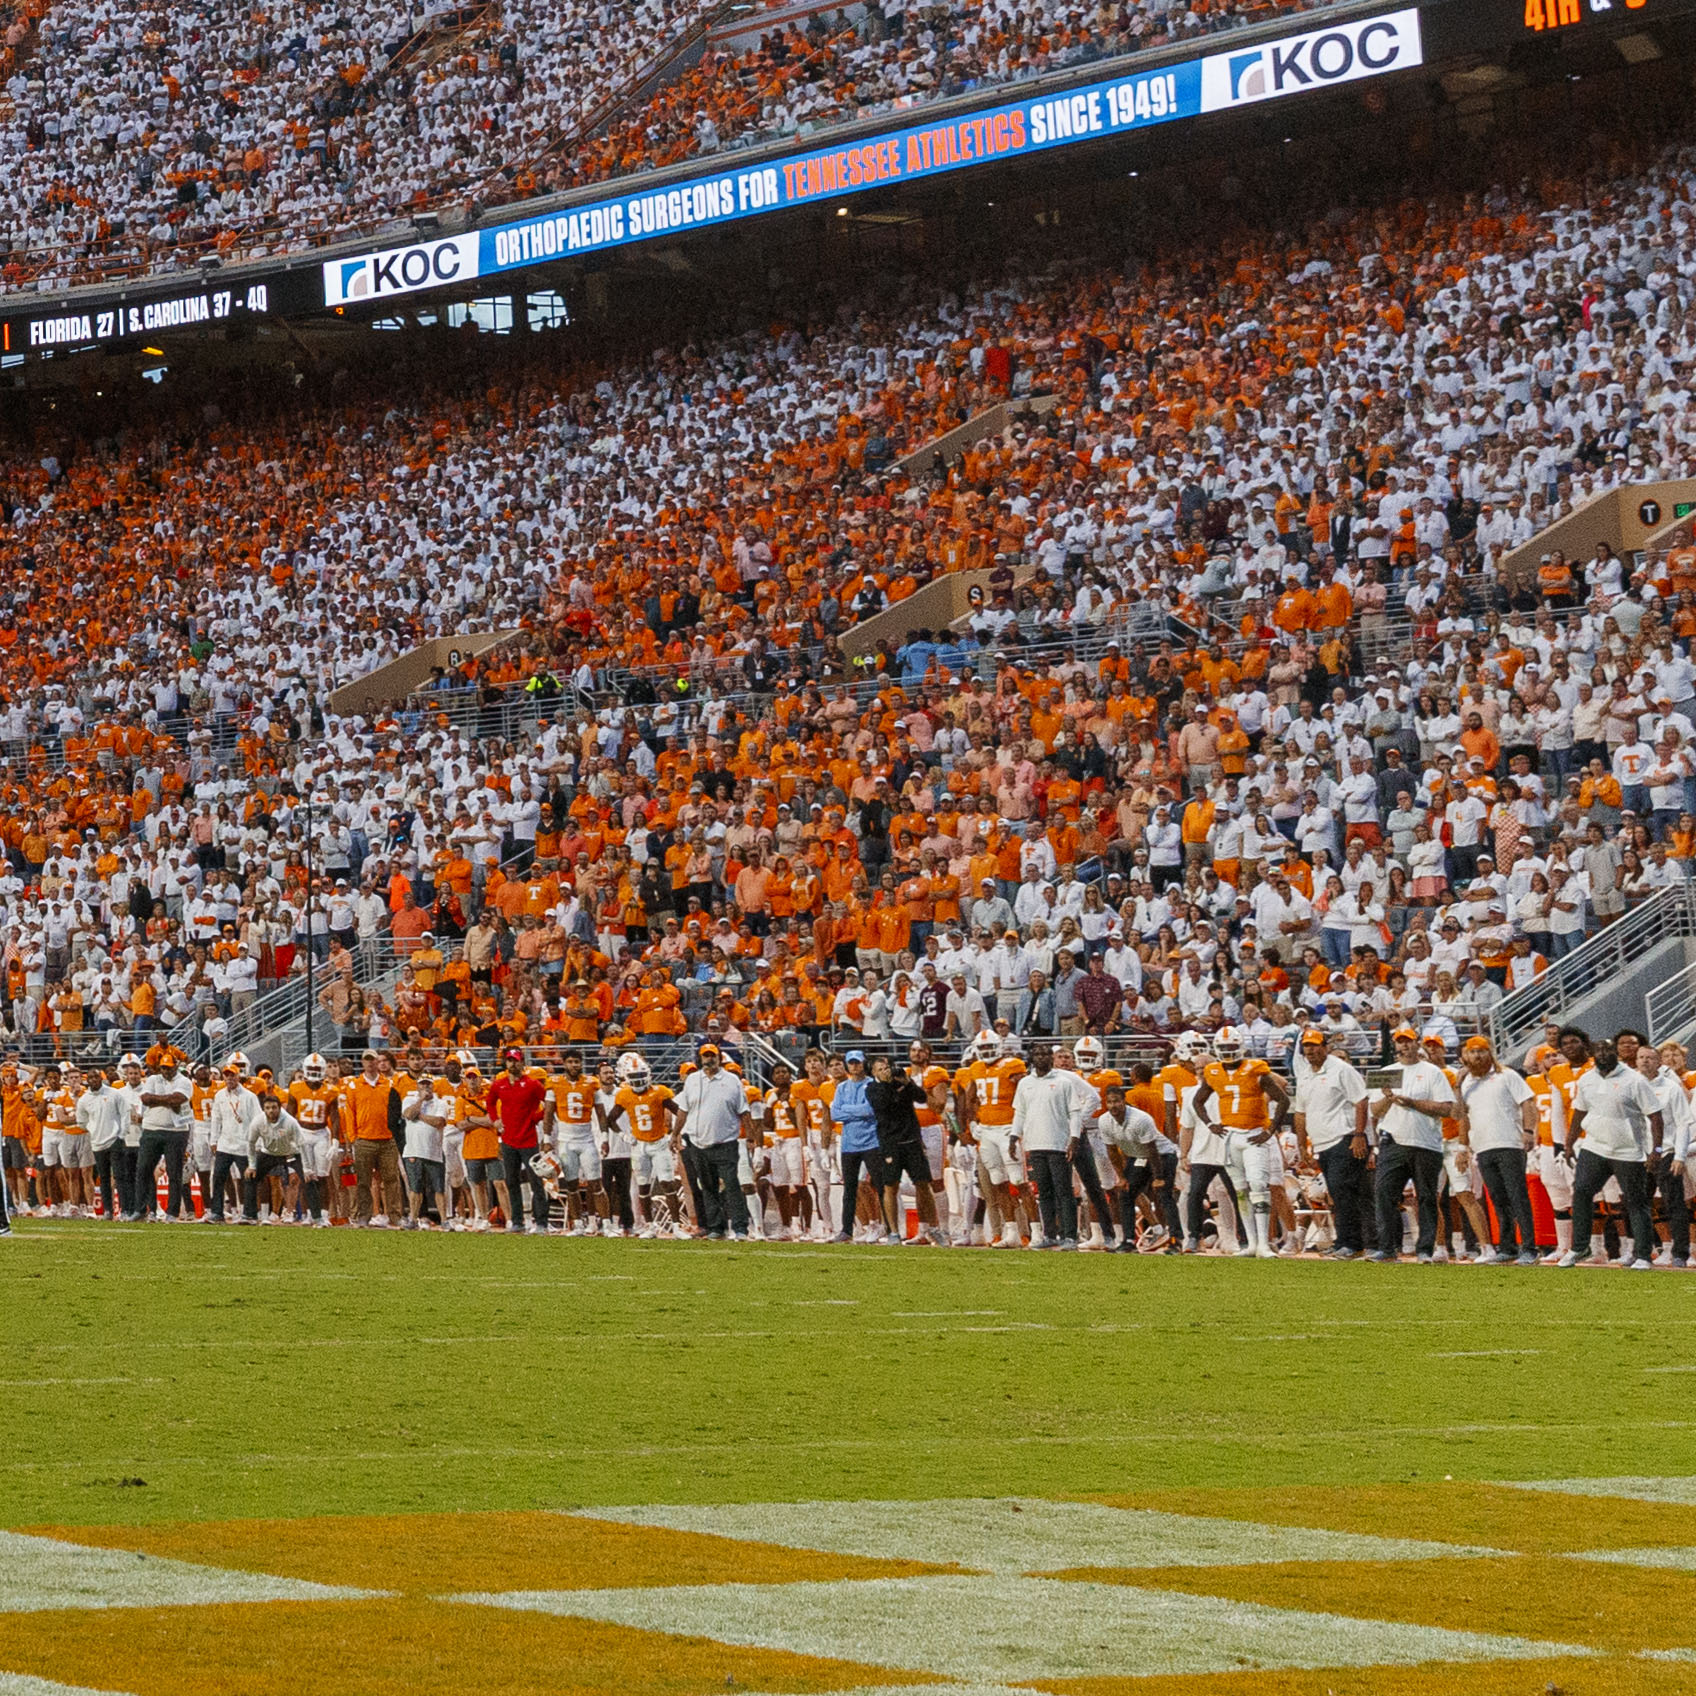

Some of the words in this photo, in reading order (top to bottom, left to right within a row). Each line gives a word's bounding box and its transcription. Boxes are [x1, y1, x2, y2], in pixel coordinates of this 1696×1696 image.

[1271, 21, 1401, 90] KOC
[494, 205, 624, 267] ORTHOPAEDIC
[628, 178, 735, 232] SURGEONS
[739, 168, 778, 212] FOR
[782, 139, 902, 201] TENNESSEE
[906, 110, 1026, 172] ATHLETICS
[1030, 90, 1102, 144] SINCE
[1106, 74, 1177, 126] 1949!
[372, 242, 461, 294] KOC
[30, 315, 92, 345] FLORIDA
[96, 312, 115, 338] 27
[213, 292, 232, 318] 37
[247, 285, 267, 312] 4Q
[1642, 504, 1656, 523] T
[451, 652, 458, 665] R
[922, 997, 937, 1016] 12
[300, 1099, 326, 1123] 20
[567, 1092, 584, 1119] 6
[1224, 1085, 1240, 1114] 7
[634, 1104, 653, 1132] 6
